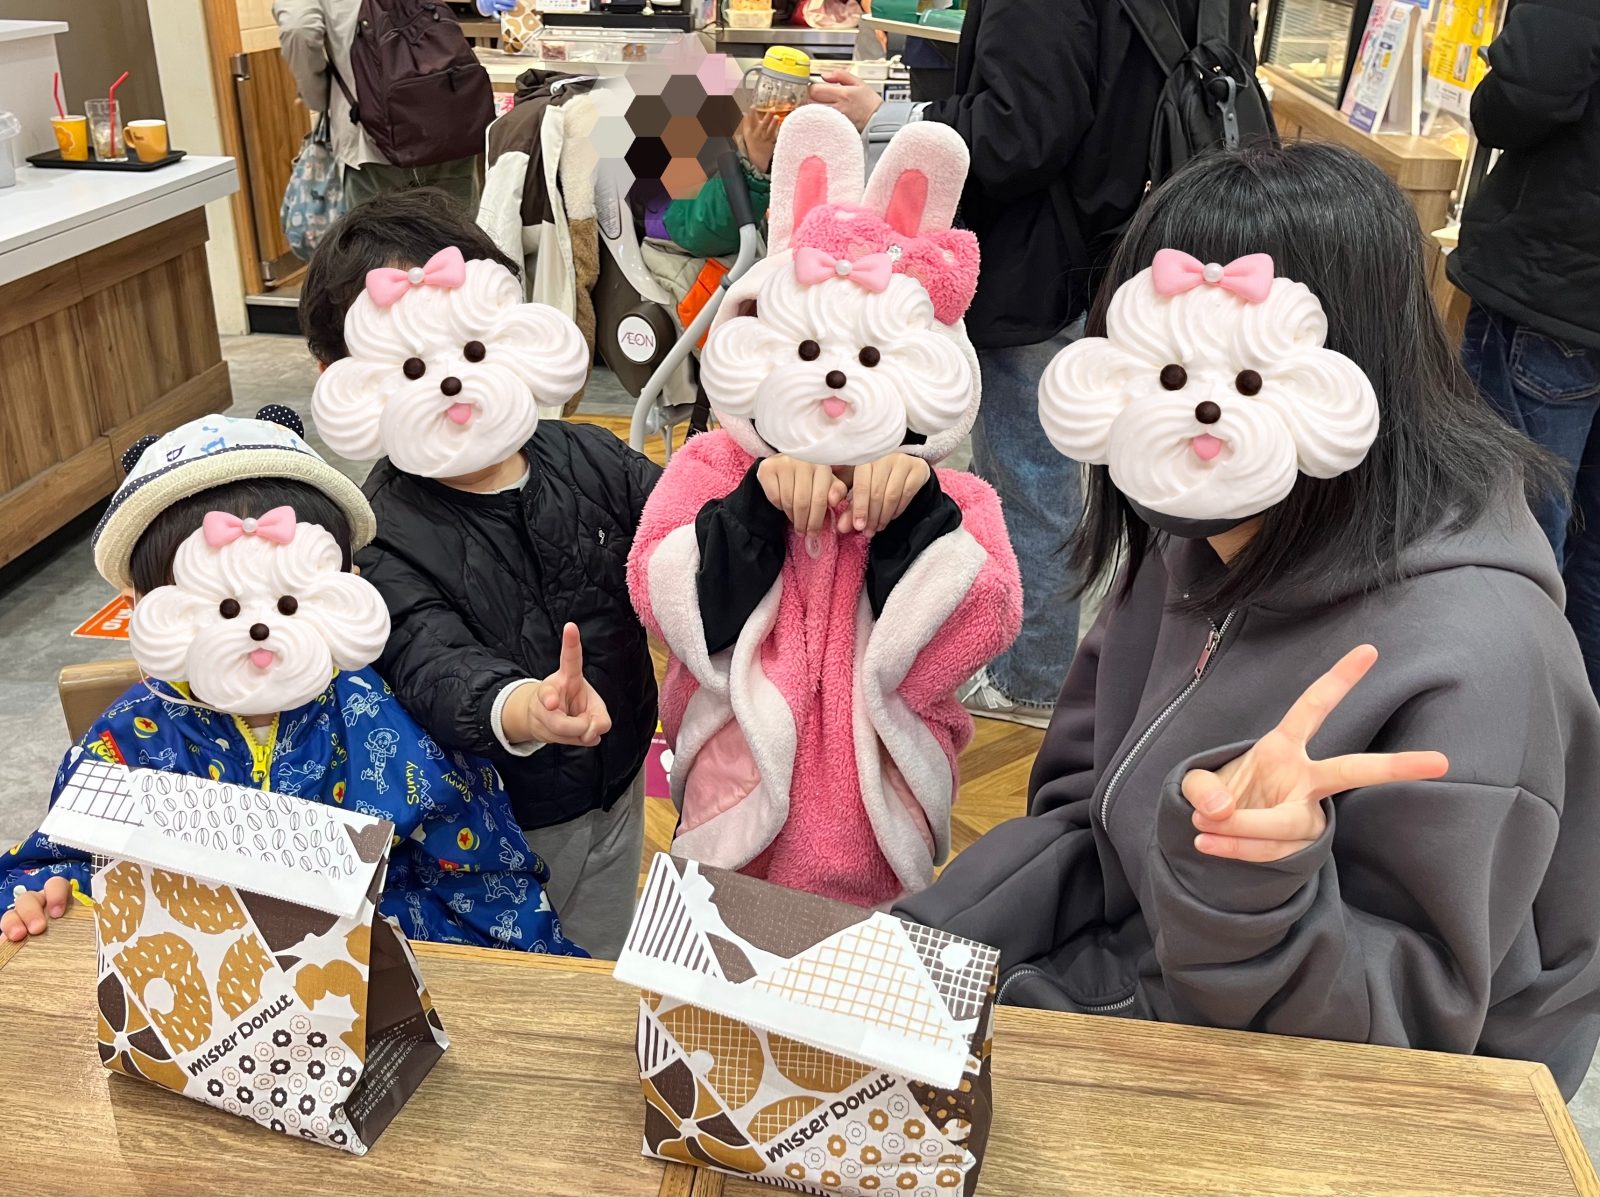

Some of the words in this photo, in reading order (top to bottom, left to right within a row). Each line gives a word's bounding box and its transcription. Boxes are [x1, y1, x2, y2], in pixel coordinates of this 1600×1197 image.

[405, 760, 420, 805] Sunny
[237, 994, 294, 1039] Donut
[829, 1073, 896, 1120] Donut
